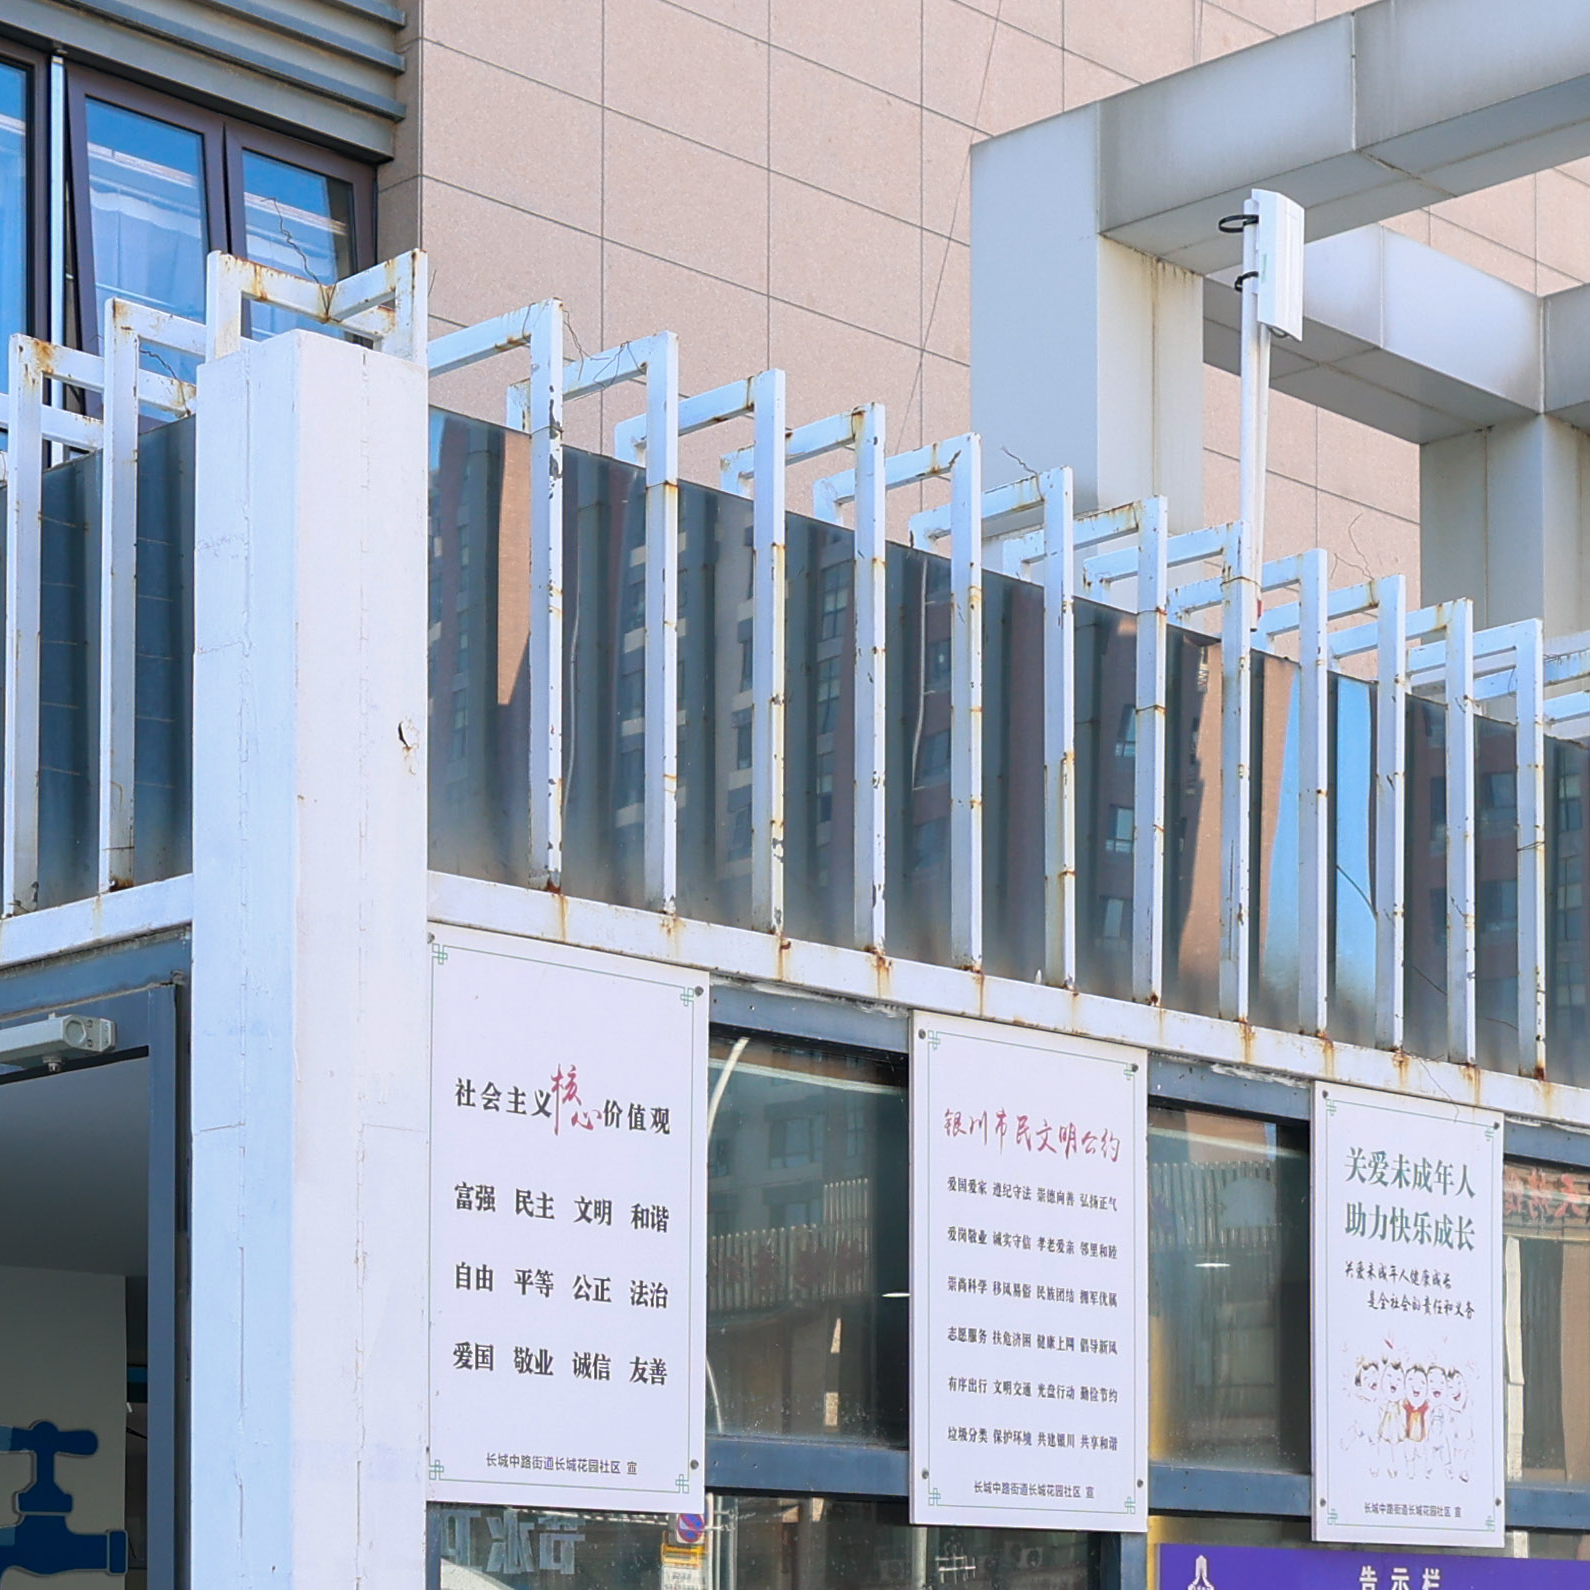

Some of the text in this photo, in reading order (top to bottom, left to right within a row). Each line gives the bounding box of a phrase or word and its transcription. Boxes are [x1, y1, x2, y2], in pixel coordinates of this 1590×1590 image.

[944, 1108, 1120, 1162] 银川市民文明公约
[1345, 1147, 1475, 1198] 关爱未成年人
[947, 1176, 987, 1195] 爱国爱家
[454, 1181, 669, 1233] 富强 民主 文明 和谐
[1345, 1202, 1475, 1251] 助力快乐成长
[1037, 1236, 1074, 1255] 孝老爱亲
[456, 1261, 668, 1309] 自由 平等 公正 法治
[993, 1281, 1031, 1298] 移风易俗
[1037, 1285, 1074, 1303] 民族团结
[948, 1326, 987, 1344] 志愿服务
[1037, 1334, 1074, 1351] 健康上网
[453, 1341, 667, 1385] 爱国 敬业 诚信 友善
[948, 1376, 987, 1394] 有序出行
[994, 1380, 1031, 1397] 文明交通
[1038, 1383, 1075, 1400] 光盘行动
[993, 1429, 1032, 1446] 保护环境
[1081, 1434, 1118, 1451] 共享和谐
[486, 1453, 621, 1474] 长城中路街道长城花园社区
